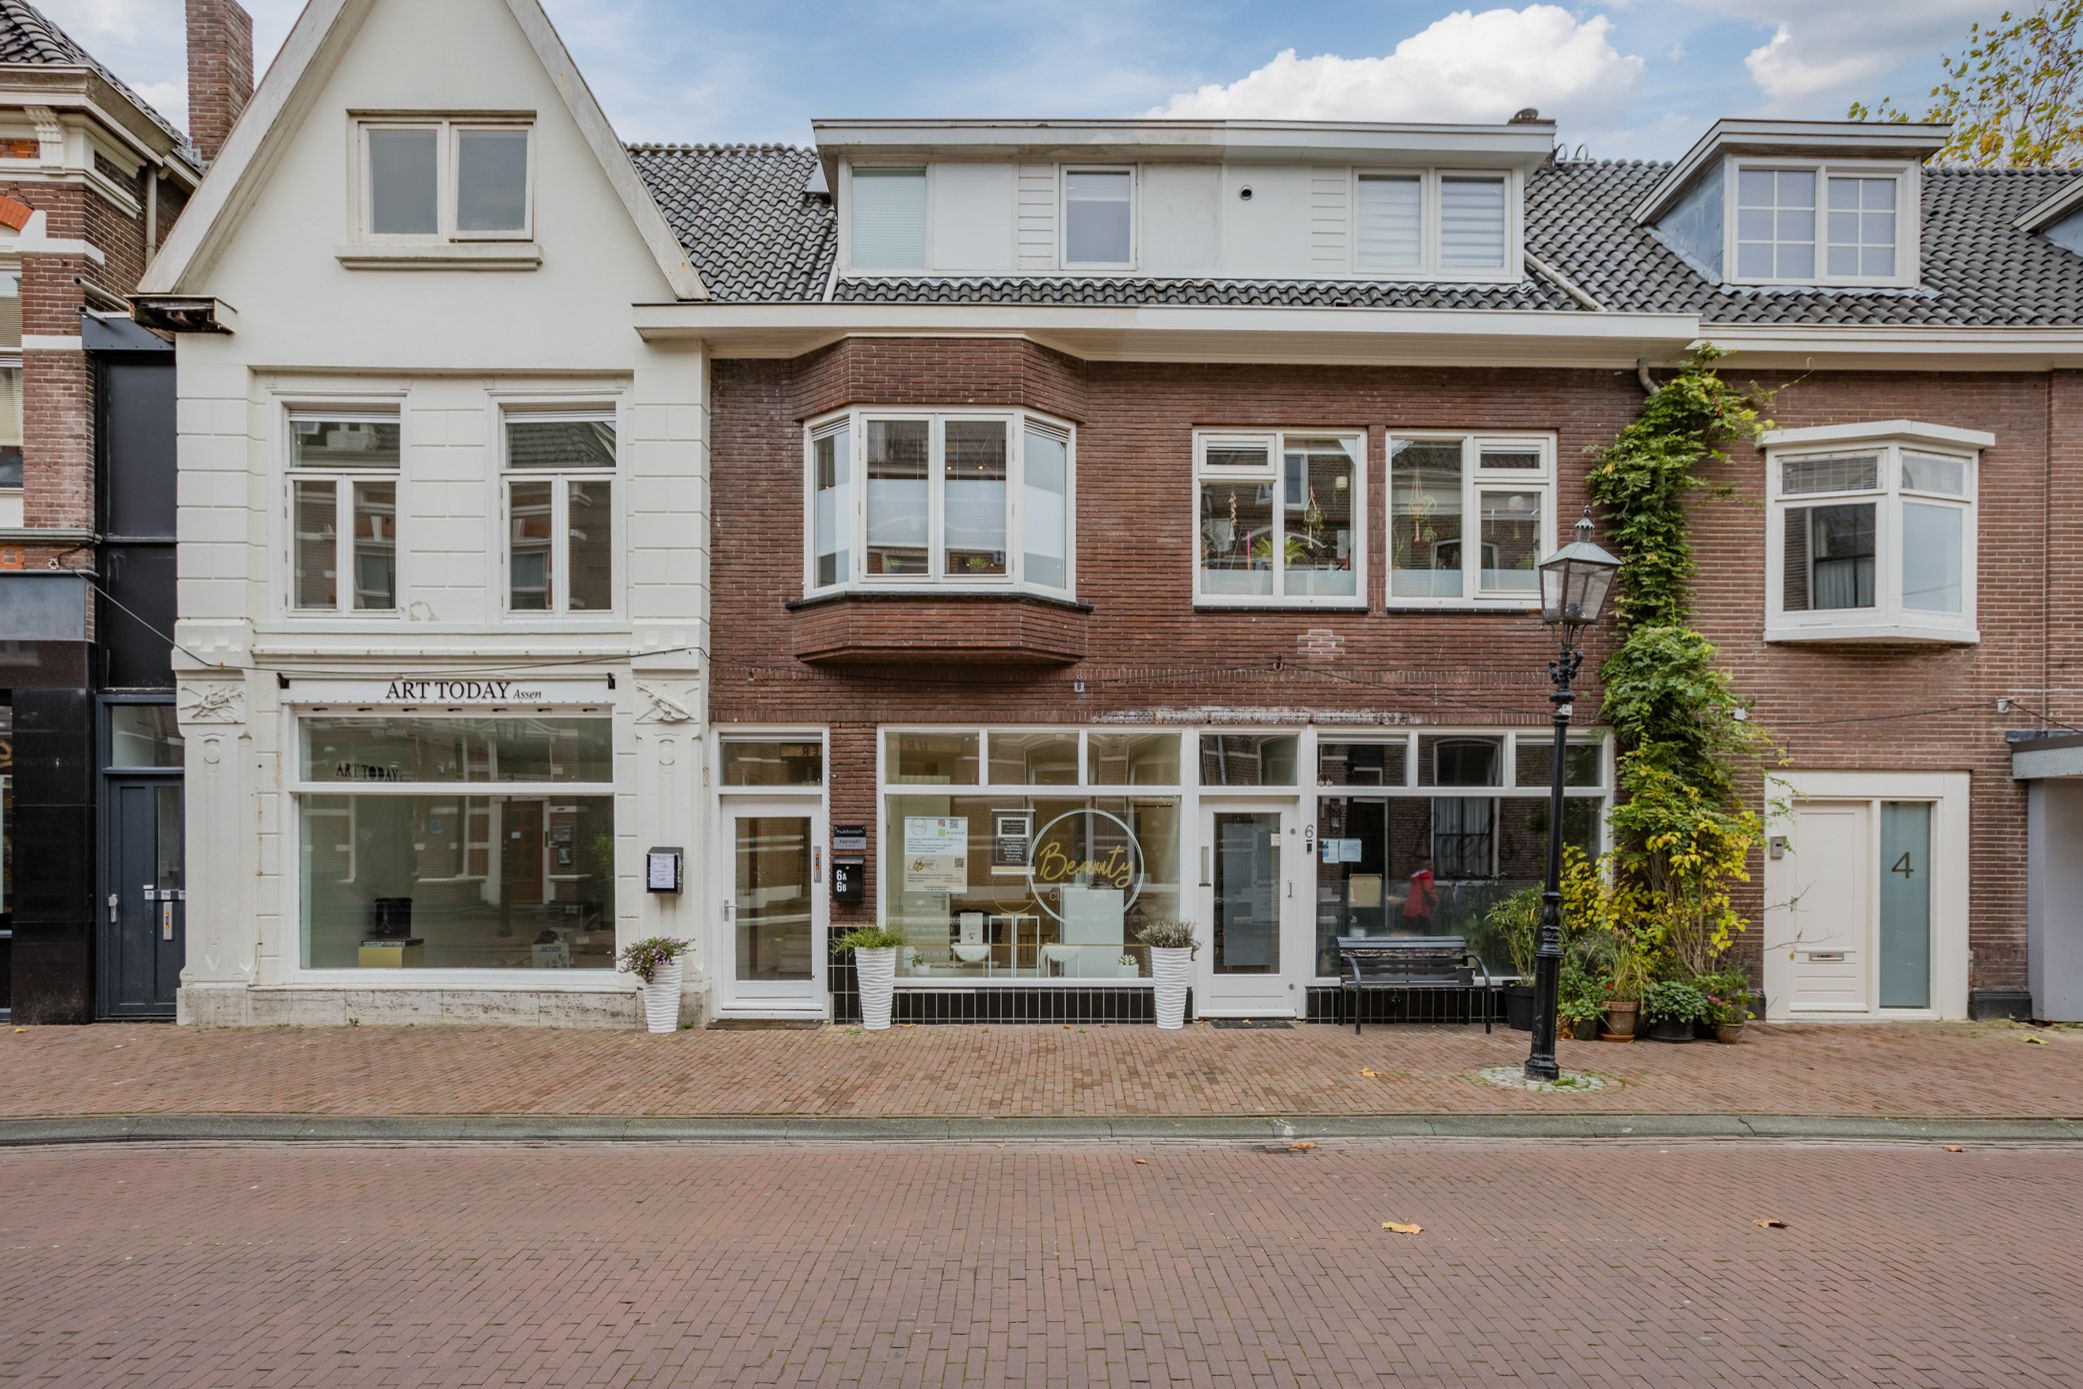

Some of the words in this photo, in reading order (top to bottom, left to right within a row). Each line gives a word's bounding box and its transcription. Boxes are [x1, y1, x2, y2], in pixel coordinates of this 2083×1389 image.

[386, 681, 430, 700] ART
[435, 681, 511, 700] TODAY
[513, 689, 542, 700] Assen
[335, 762, 359, 778] ART
[361, 764, 399, 782] TODAY
[1305, 824, 1314, 838] 6
[1039, 842, 1134, 888] Beauty
[1892, 851, 1914, 879] 4
[836, 869, 847, 881] 6A
[836, 881, 847, 892] 6B
